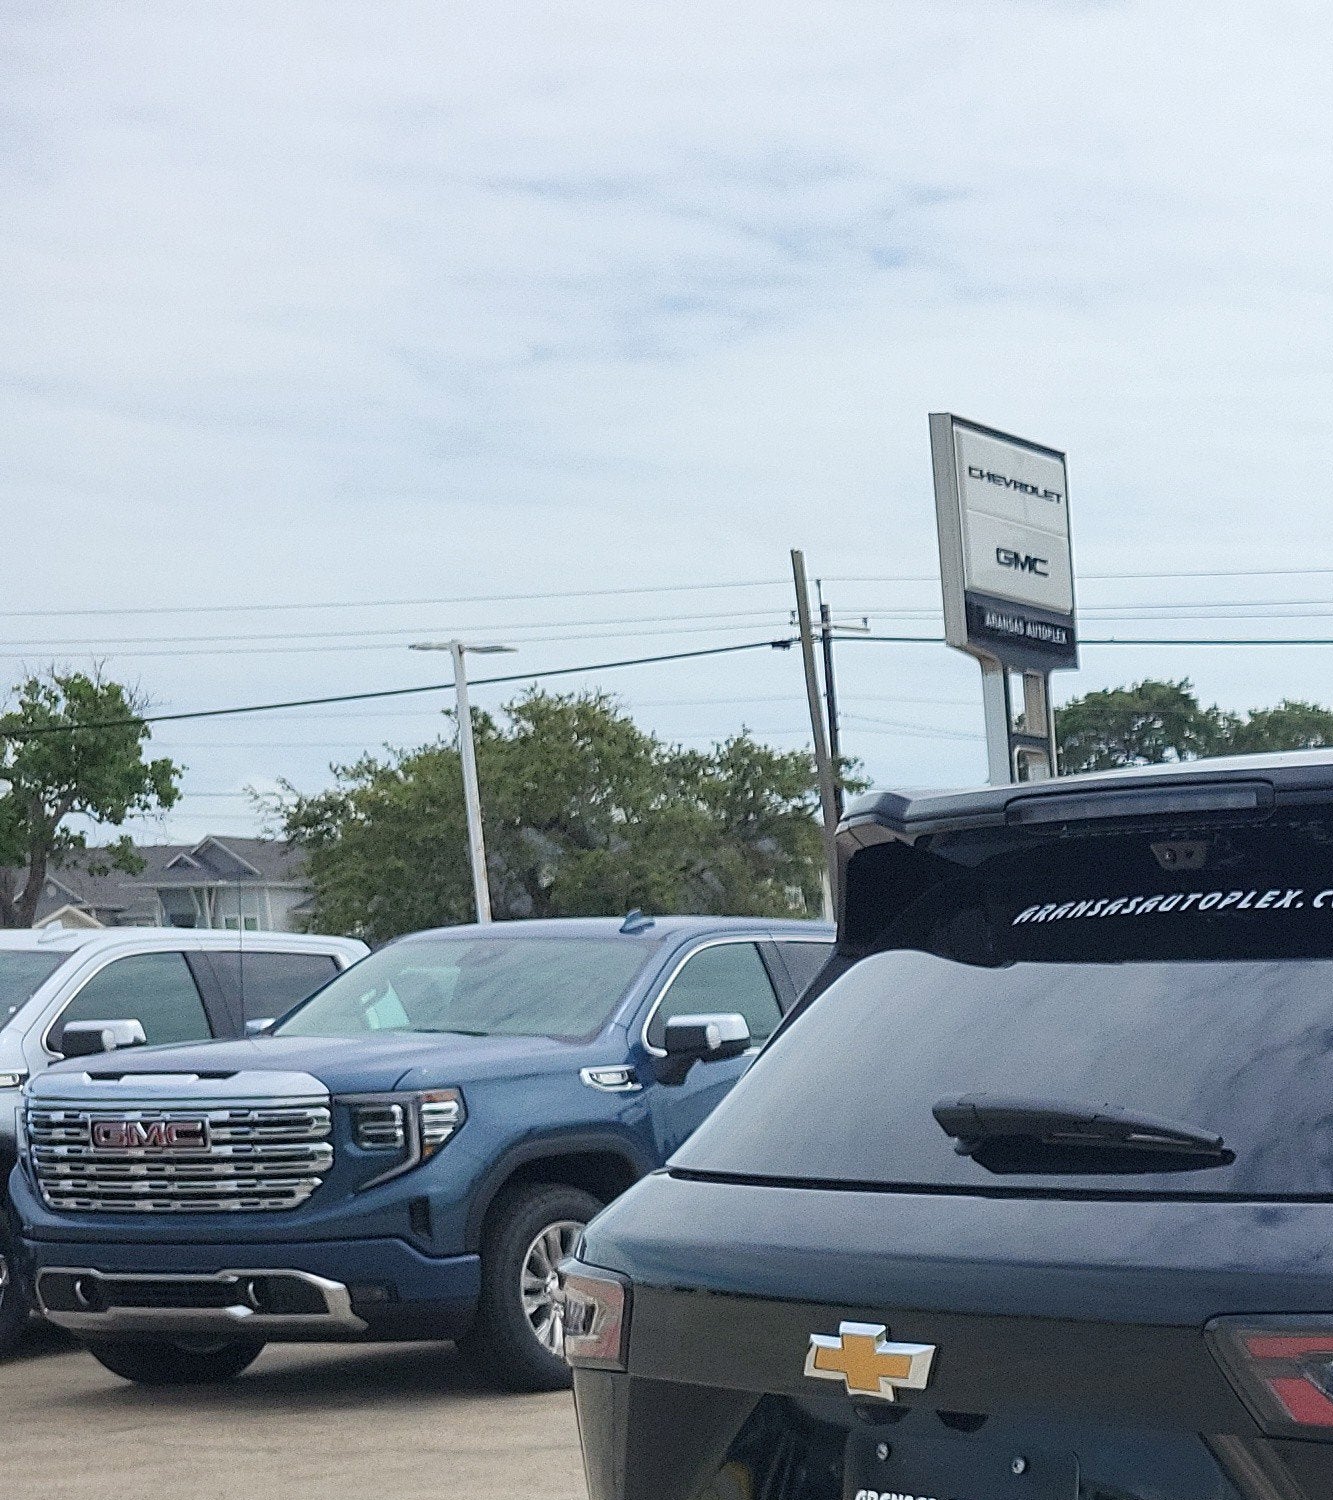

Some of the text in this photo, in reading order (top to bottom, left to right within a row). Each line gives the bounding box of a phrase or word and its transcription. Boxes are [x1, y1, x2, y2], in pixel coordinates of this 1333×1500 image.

[968, 466, 1063, 504] CHEVROLET
[996, 547, 1049, 577] GMC
[985, 611, 1067, 645] ARANSAS AUTOPLEX
[94, 1121, 204, 1147] GMC
